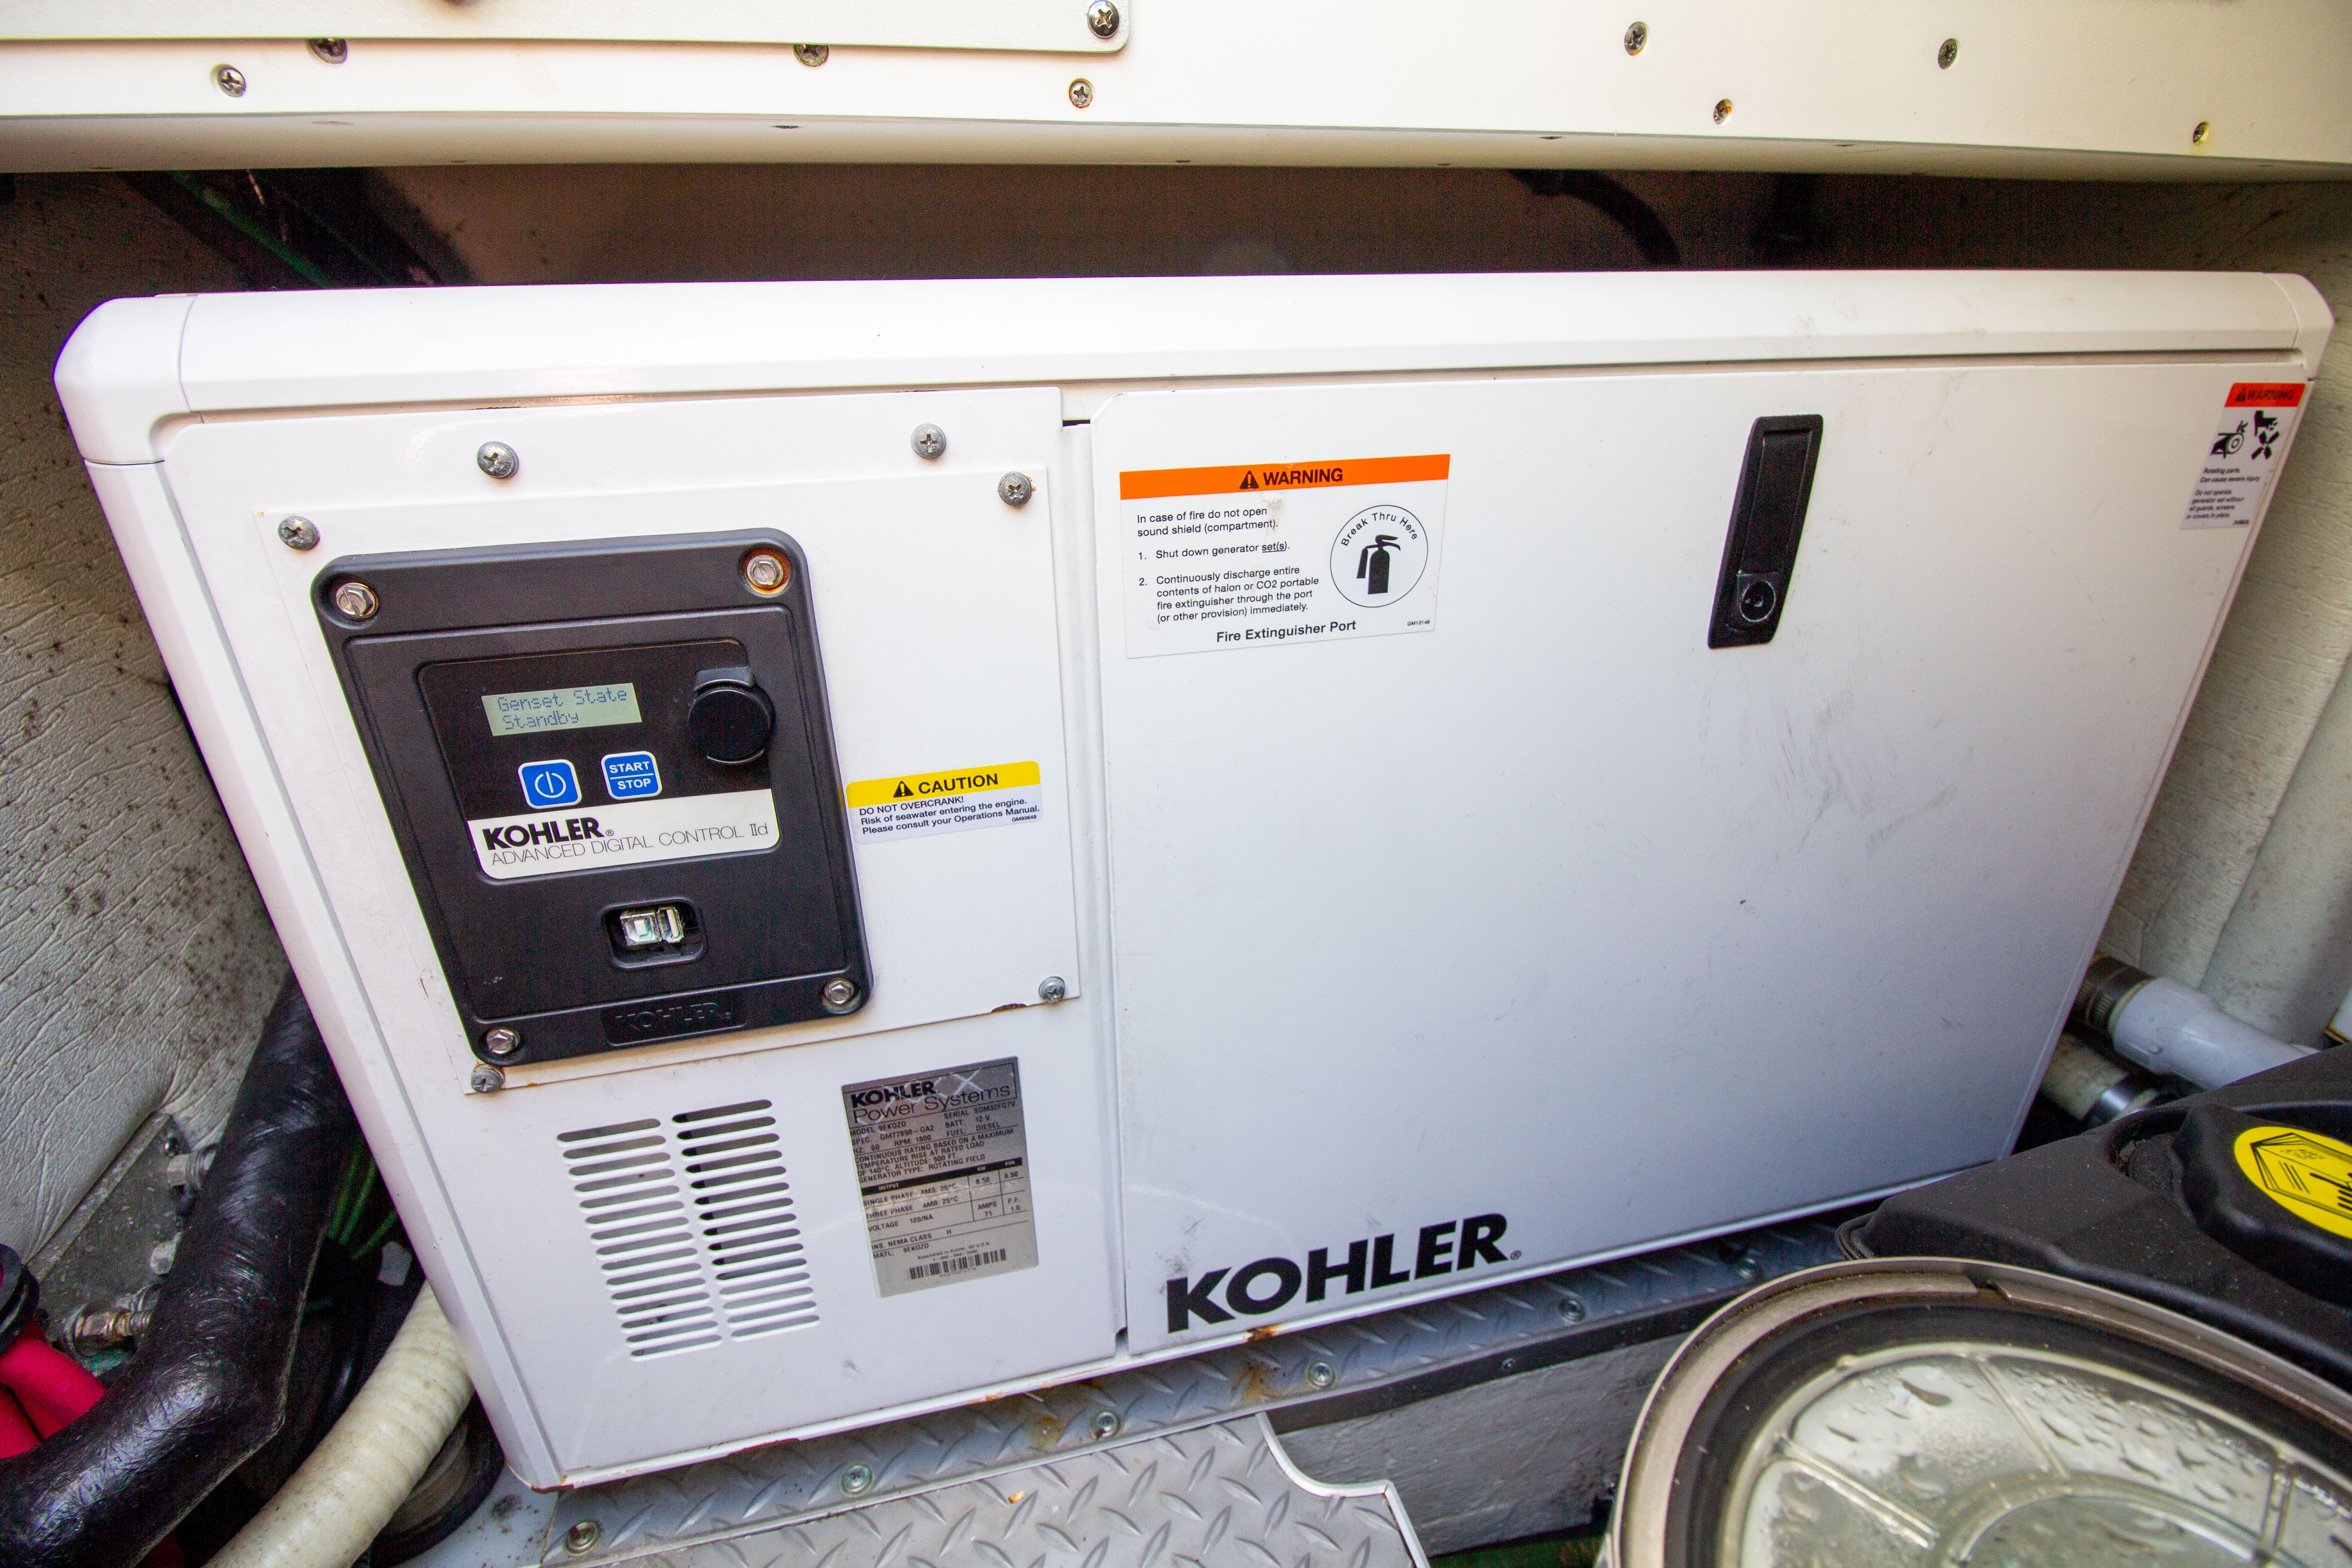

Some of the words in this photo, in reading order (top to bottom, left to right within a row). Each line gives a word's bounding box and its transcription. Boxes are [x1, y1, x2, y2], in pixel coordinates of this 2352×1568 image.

[2247, 390, 2295, 399] WARNING
[1263, 467, 1343, 486] WARNING
[1137, 514, 1146, 524] In
[1149, 514, 1173, 523] case
[1176, 511, 1186, 521] of
[1189, 511, 1205, 520] fire
[1208, 510, 1220, 519] do
[1224, 509, 1240, 518] not
[1243, 508, 1267, 518] open
[1137, 526, 1168, 537] sound
[1172, 524, 1201, 534] shield
[1204, 519, 1278, 534] (compartment).
[1341, 518, 1368, 546] Break
[1372, 512, 1396, 522] Thru
[1399, 515, 1420, 539] Here
[1138, 552, 1147, 560] 1.
[1156, 549, 1179, 559] Shut
[1181, 548, 1209, 557] down
[1212, 544, 1259, 557] generator
[1262, 541, 1289, 553] set(s).
[1139, 578, 1147, 586] 2.
[1156, 572, 1220, 584] Continuously
[1223, 569, 1270, 579] discharge
[1273, 566, 1300, 576] entire
[1156, 587, 1199, 598] contents
[1202, 585, 1212, 594] of
[1215, 583, 1240, 593] halon
[1256, 580, 1277, 589] CO2
[1280, 577, 1319, 589] portable
[1157, 601, 1172, 610] fire
[1175, 597, 1235, 609] extinguisher
[1237, 593, 1273, 603] through
[1276, 592, 1291, 600] the
[1294, 590, 1313, 601] port
[1157, 614, 1171, 624] (or
[1173, 612, 1198, 621] other
[1201, 607, 1247, 621] provision)
[1250, 602, 1308, 614] immediately.
[1217, 631, 1241, 642] Fire
[1245, 624, 1326, 640] Extinguisher
[1330, 620, 1356, 632] Port
[497, 692, 564, 712] Genset
[573, 687, 627, 705] State
[502, 710, 579, 730] Standby
[610, 761, 650, 774] START
[617, 778, 652, 790] STOP
[918, 773, 998, 794] CAUTION
[859, 807, 874, 816] DO
[877, 804, 897, 813] NOT
[900, 796, 964, 810] OVERCRANK!
[861, 816, 882, 825] Risk
[883, 814, 892, 822] of
[895, 810, 937, 821] seawater
[939, 805, 976, 815] entering
[995, 799, 1027, 808] engine.
[862, 825, 893, 835] Please
[896, 819, 929, 830] consult
[931, 818, 952, 827] your
[954, 811, 1003, 823] Operations
[1005, 805, 1040, 816] Manual.
[492, 843, 585, 866] ADVANCED
[591, 835, 654, 854] DIGITAL
[659, 825, 745, 846] CONTROL
[851, 1081, 936, 1107] KOHLER
[853, 1102, 916, 1124] Power
[924, 1085, 1010, 1112] Systems
[944, 1109, 969, 1119] SERIAL
[851, 1127, 874, 1136] MODEL
[976, 1122, 1000, 1132] DIESEL
[855, 1149, 902, 1163] CONTINUOUS
[905, 1144, 931, 1154] RATING
[934, 1139, 956, 1148] BASED
[978, 1128, 1013, 1140] MAXIMUM
[856, 1155, 909, 1170] TEMPERATURE
[911, 1152, 927, 1160] RISE
[941, 1145, 963, 1154] RATED
[966, 1141, 984, 1149] LOAD
[858, 1170, 901, 1183] GENERATOR
[928, 1158, 963, 1170] ROTATING
[966, 1154, 985, 1162] FIELD
[863, 1196, 888, 1206] SINGLE
[865, 1210, 887, 1219] THREE
[891, 1205, 913, 1214] PHASE
[868, 1221, 898, 1232] VOLTAGE
[910, 1214, 933, 1223] 120/NA
[978, 1201, 996, 1210] AMPS
[888, 1238, 907, 1246] NEMA
[910, 1233, 931, 1242] CLASS
[1166, 1213, 1508, 1333] KOHLER
